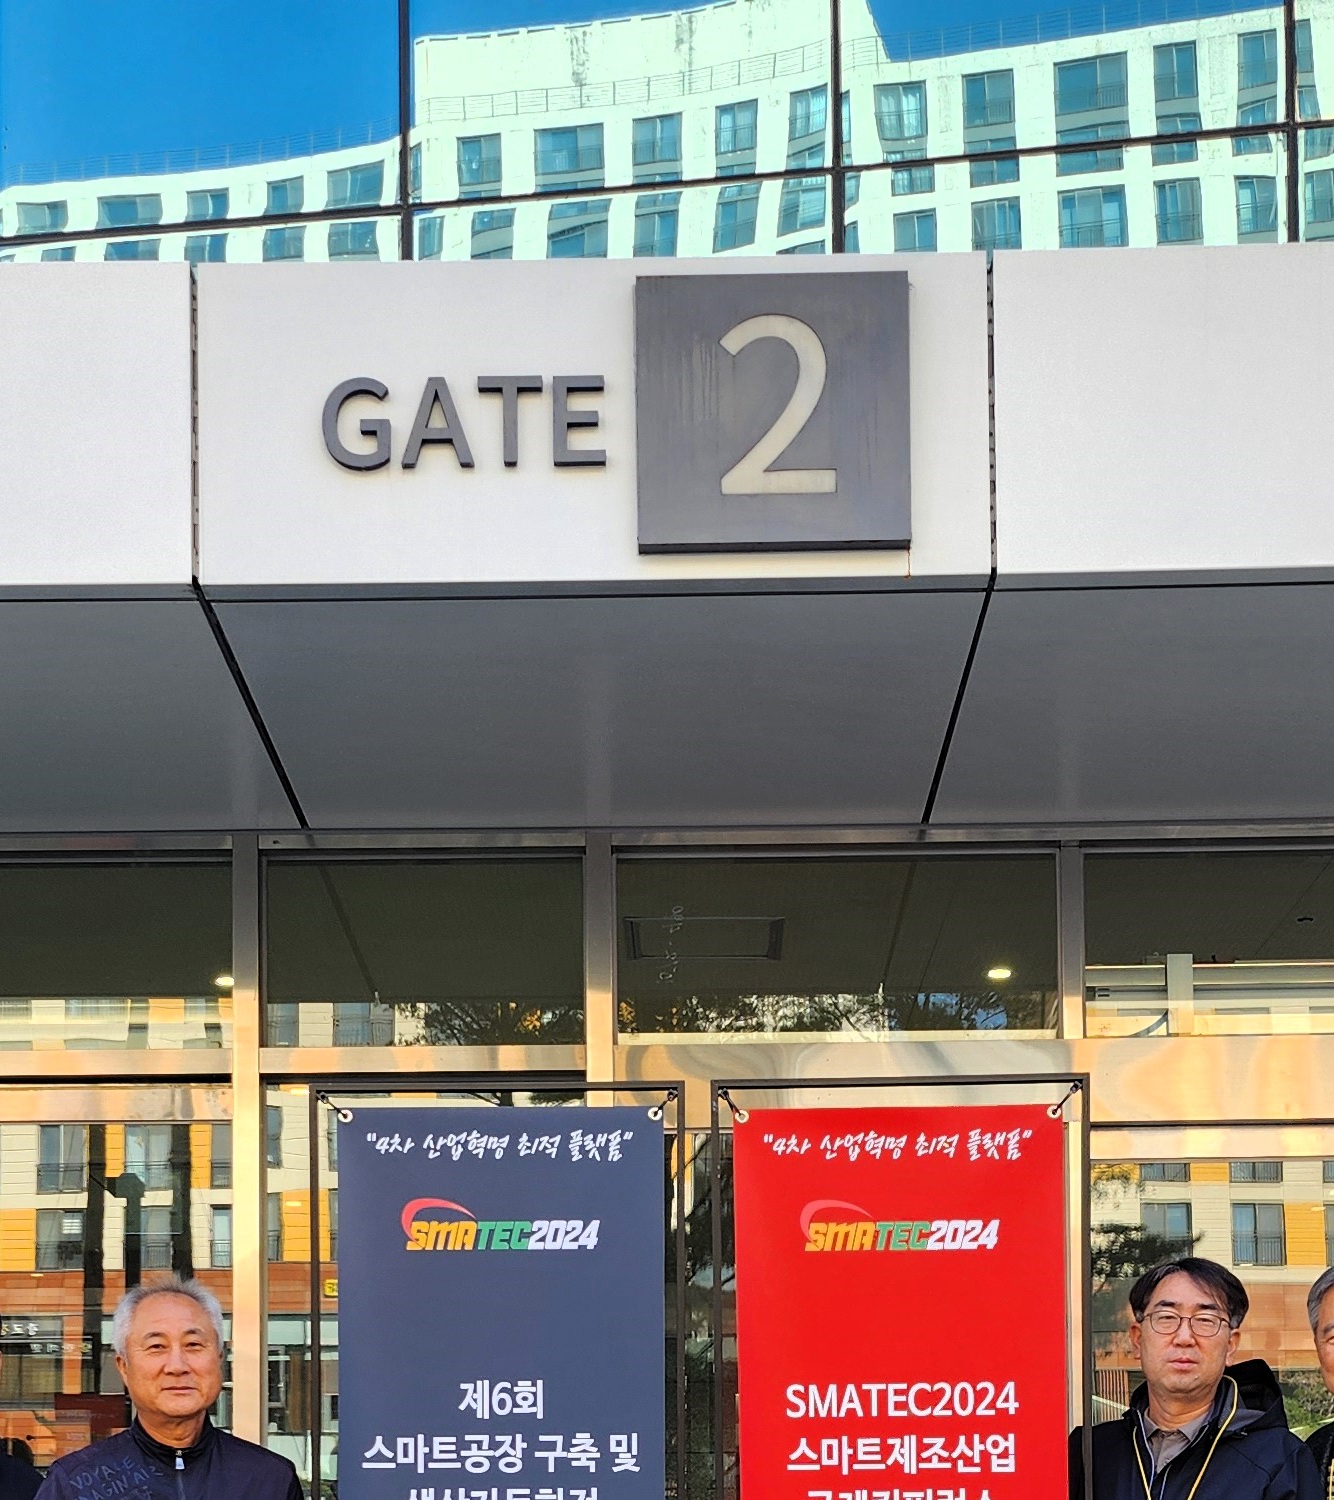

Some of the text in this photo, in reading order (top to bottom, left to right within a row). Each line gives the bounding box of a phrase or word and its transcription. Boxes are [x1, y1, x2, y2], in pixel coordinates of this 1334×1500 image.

[321, 313, 837, 495] GATE 2
[423, 1130, 510, 1161] 산업혁명
[518, 1134, 559, 1158] 최적
[820, 1130, 907, 1161] 산업혁명
[915, 1133, 958, 1159] 최적
[405, 1219, 600, 1251] SMATEC2024
[804, 1219, 1000, 1252] SMATEC2024
[458, 1379, 544, 1420] 제6회
[785, 1381, 1019, 1419] SMATEC2024
[362, 1432, 641, 1474] 스마트공장 구축 및
[786, 1433, 1016, 1475] 스마트제조산업
